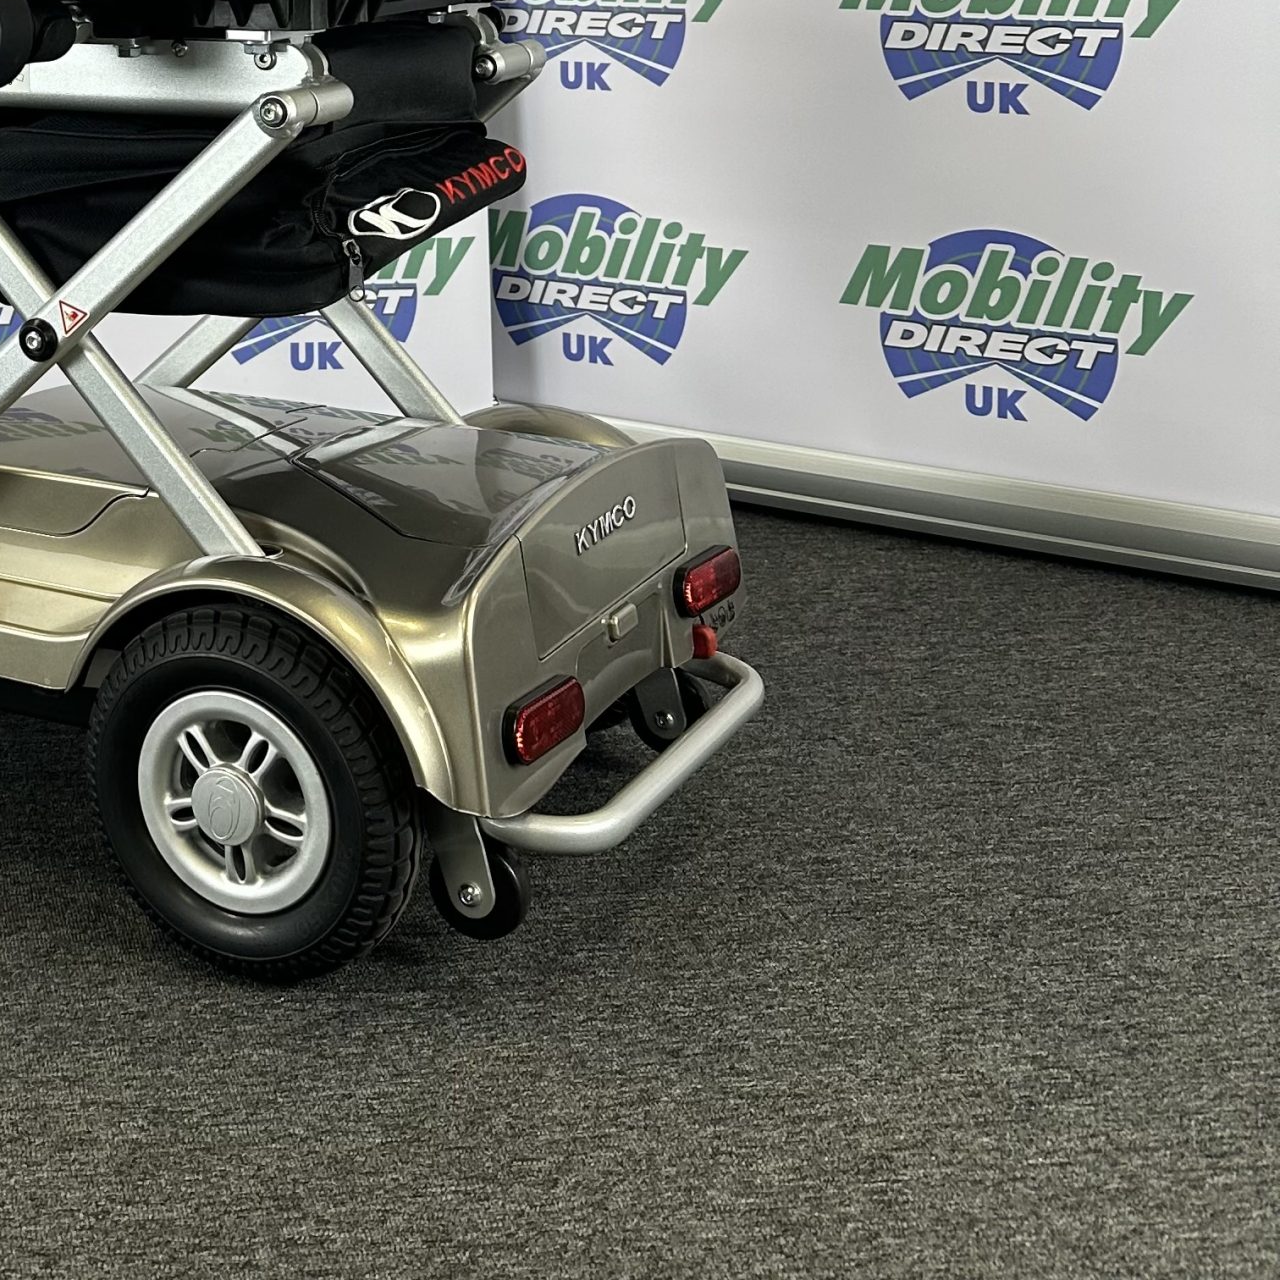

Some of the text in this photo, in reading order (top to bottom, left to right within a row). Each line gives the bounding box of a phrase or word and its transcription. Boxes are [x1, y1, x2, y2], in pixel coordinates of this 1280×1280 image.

[883, 21, 1123, 59] DIRECT
[560, 60, 612, 91] UK
[966, 81, 1030, 116] UK
[435, 147, 526, 205] KYMCO
[496, 275, 684, 320] DIRECT
[839, 244, 1194, 357] Mobility
[290, 341, 344, 371] UK
[562, 332, 614, 367] UK
[882, 322, 1116, 371] DIRECT
[965, 383, 1028, 422] UK
[574, 495, 636, 556] KYMCO
